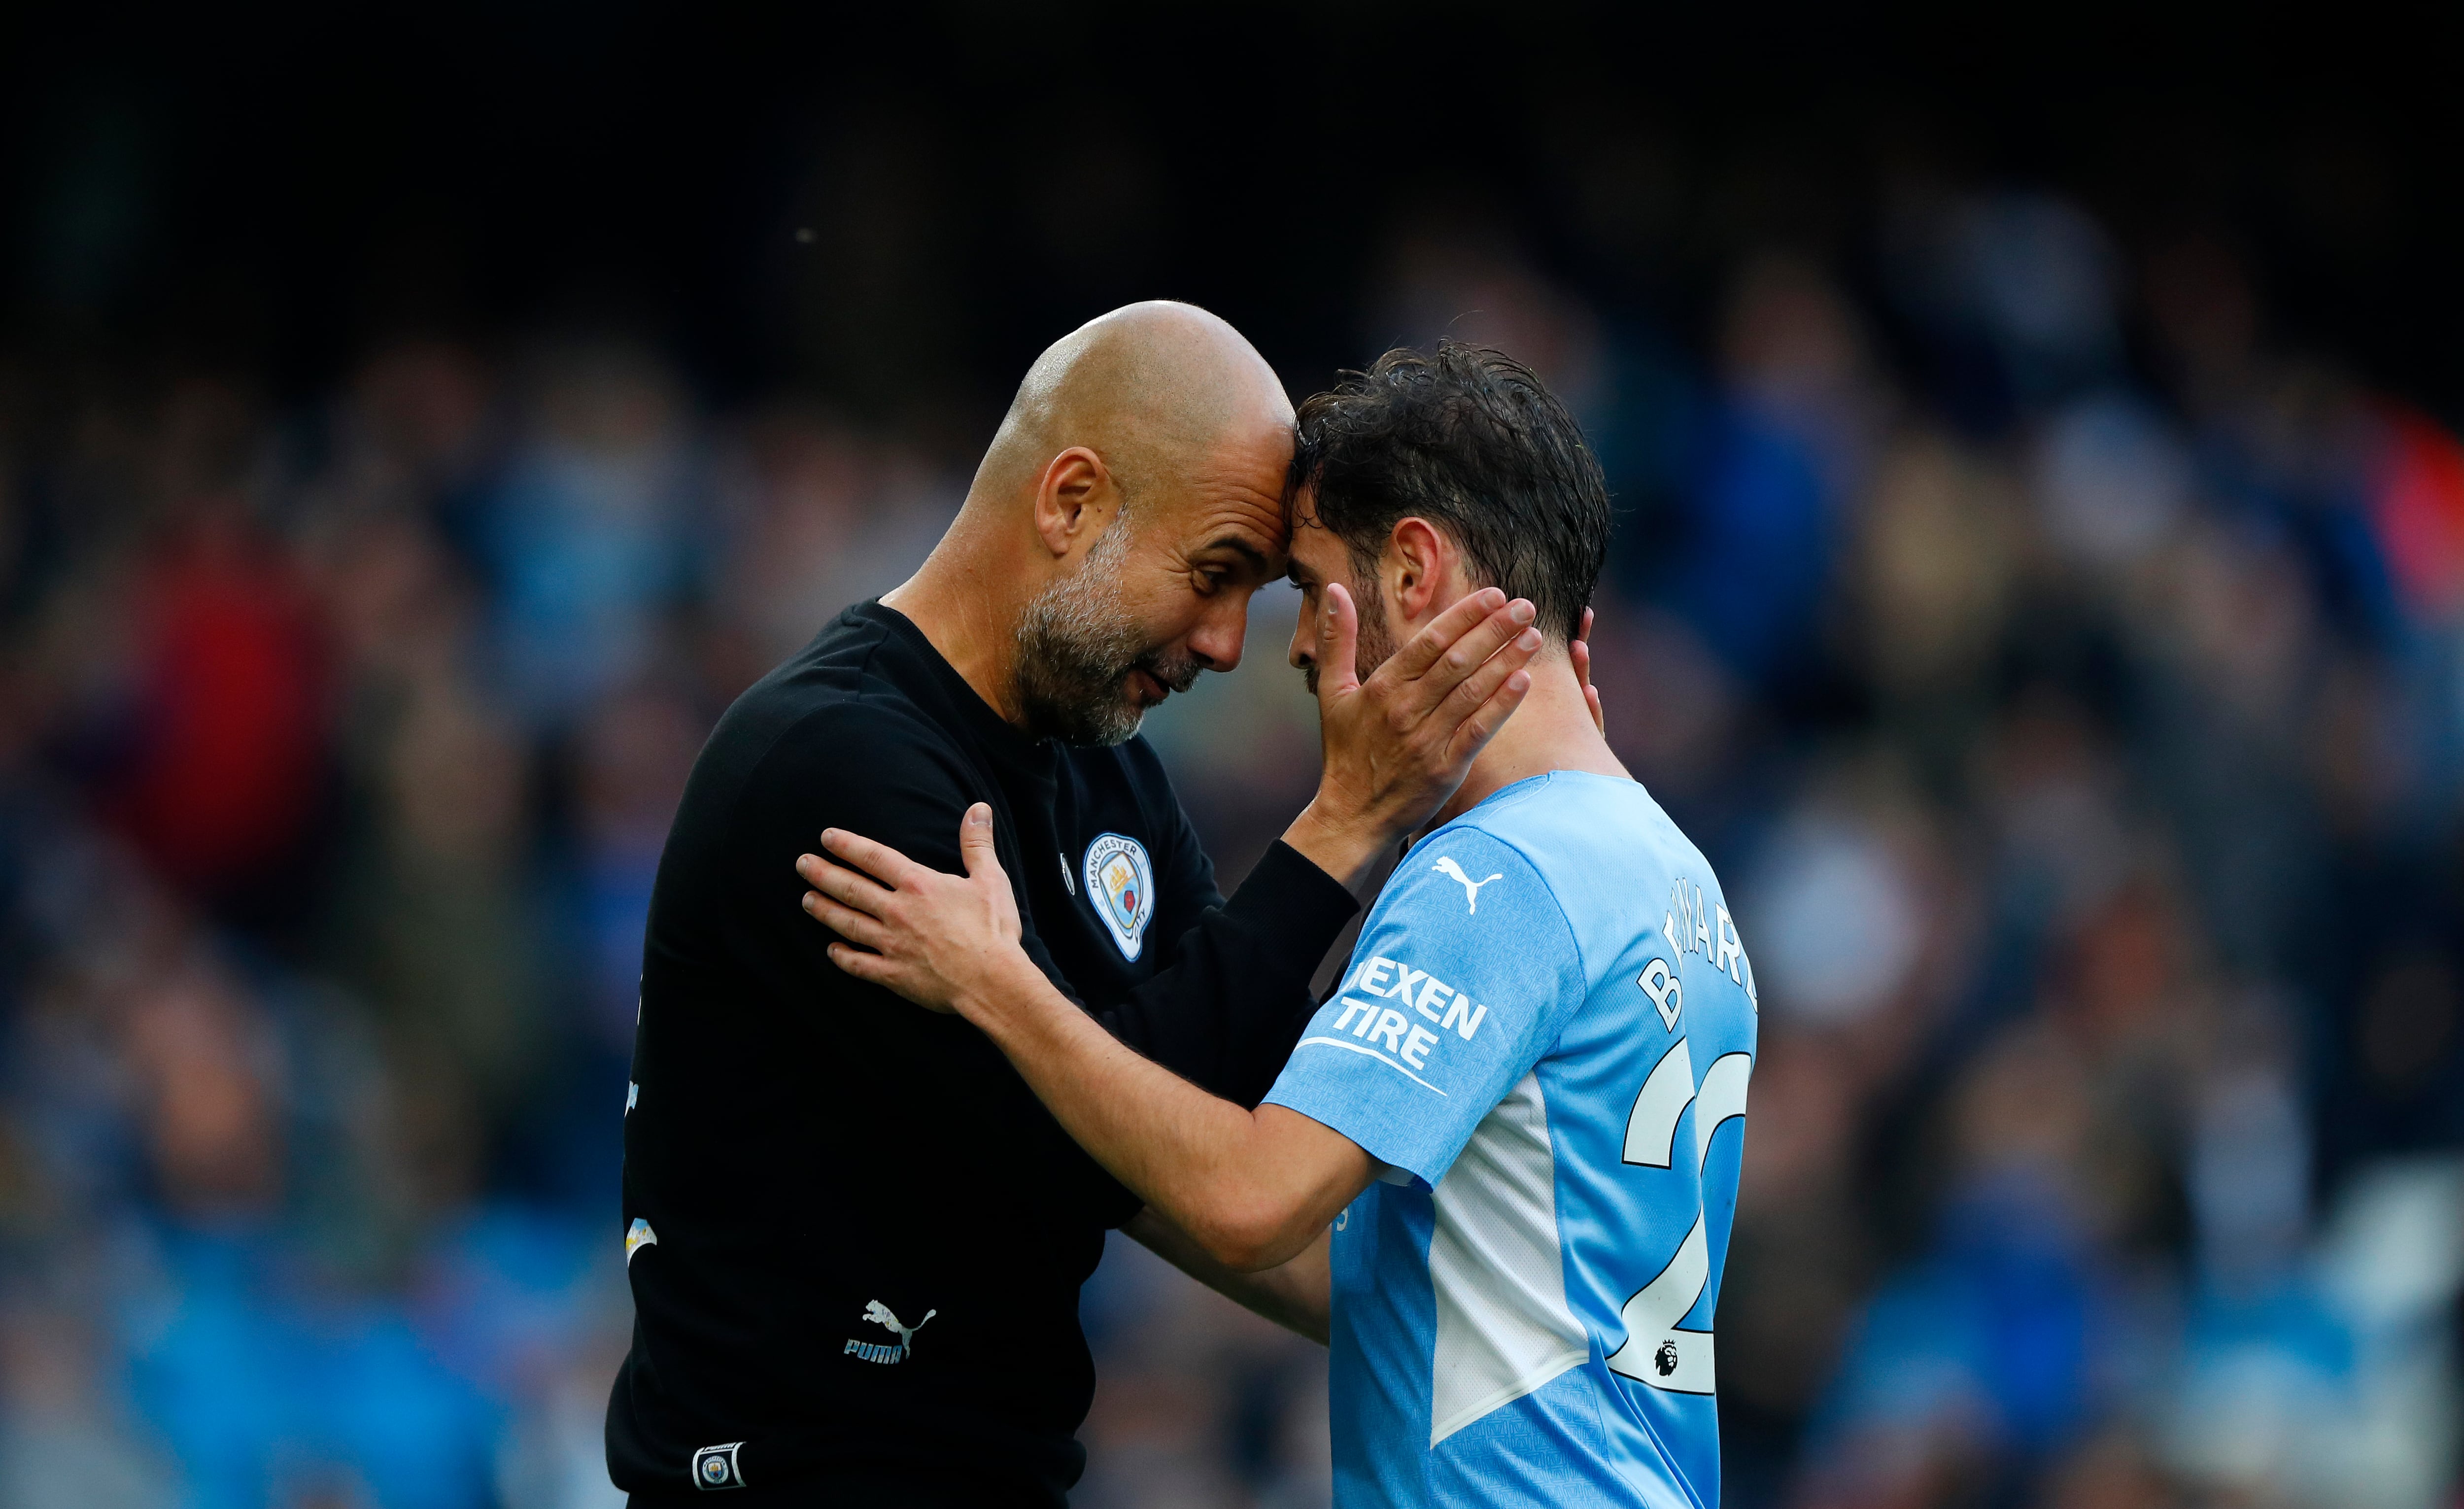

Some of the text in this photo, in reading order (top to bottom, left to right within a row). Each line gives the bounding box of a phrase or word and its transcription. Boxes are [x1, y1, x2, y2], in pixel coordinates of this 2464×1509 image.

[1091, 839, 1137, 889] MANCHESTER
[1333, 996, 1439, 1070] TIRE
[844, 1338, 902, 1364] PUMA
